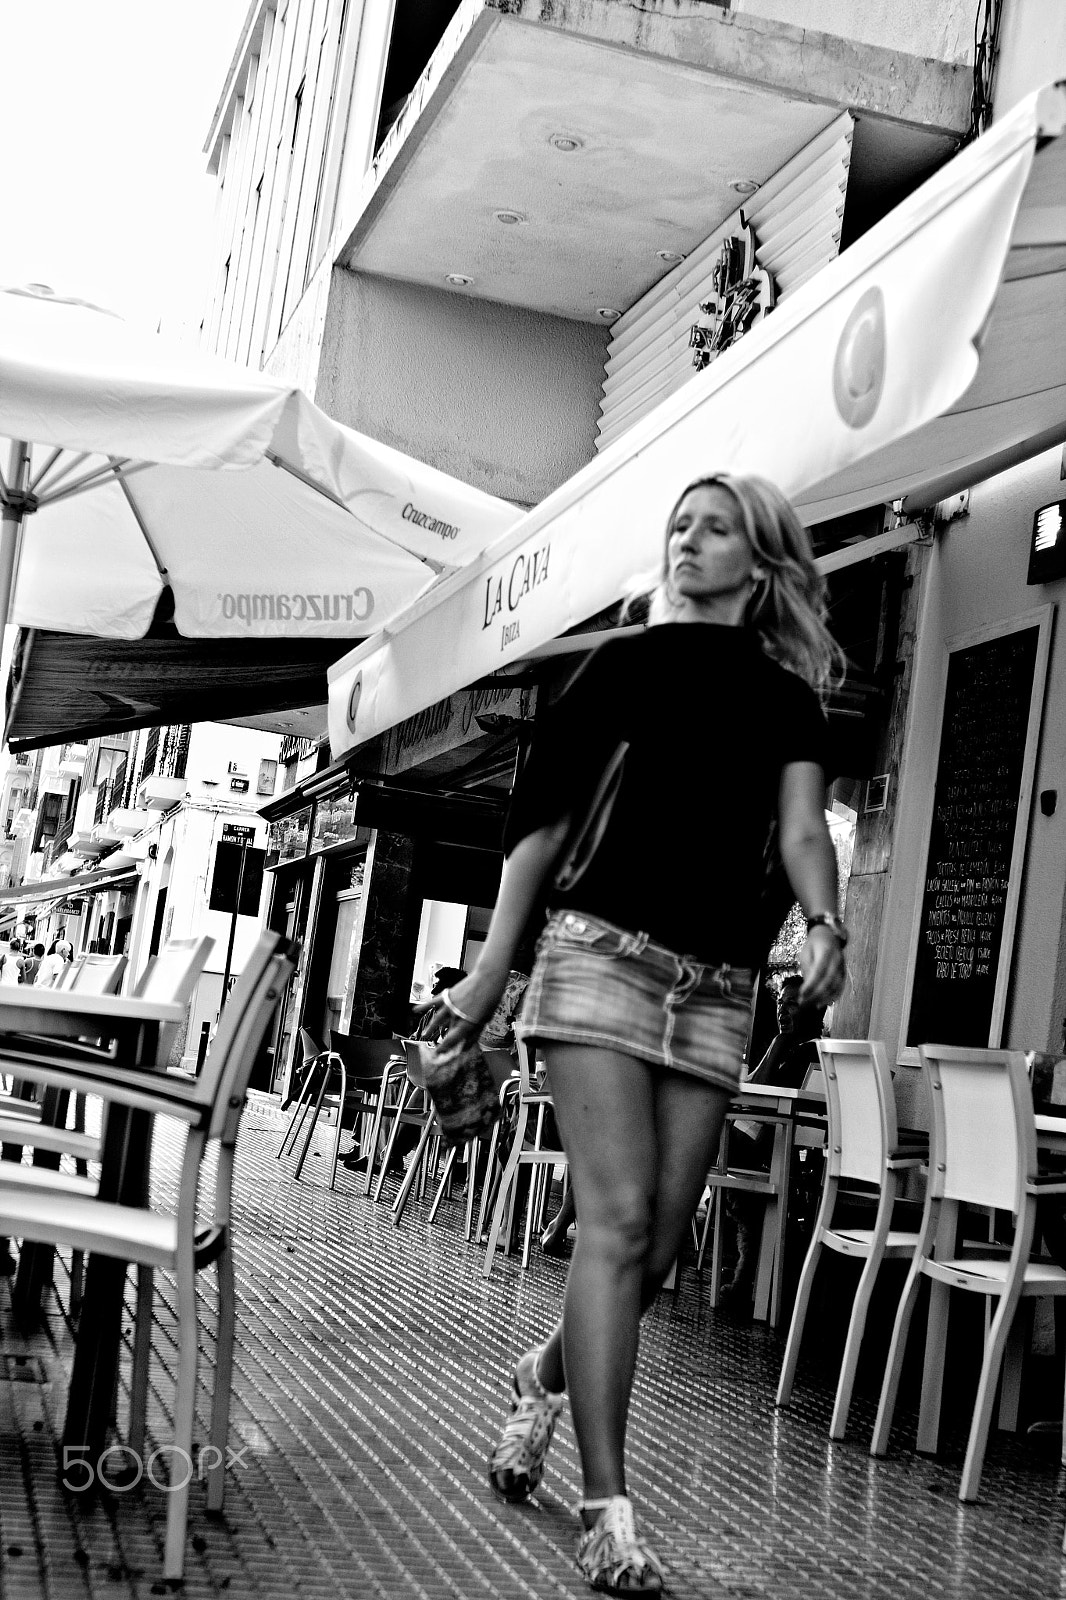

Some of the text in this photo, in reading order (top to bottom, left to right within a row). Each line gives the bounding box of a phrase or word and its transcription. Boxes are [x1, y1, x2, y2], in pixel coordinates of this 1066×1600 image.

[402, 502, 460, 540] Cruzcampo
[482, 543, 551, 631] LA CAVA
[501, 620, 520, 651] IBIZA
